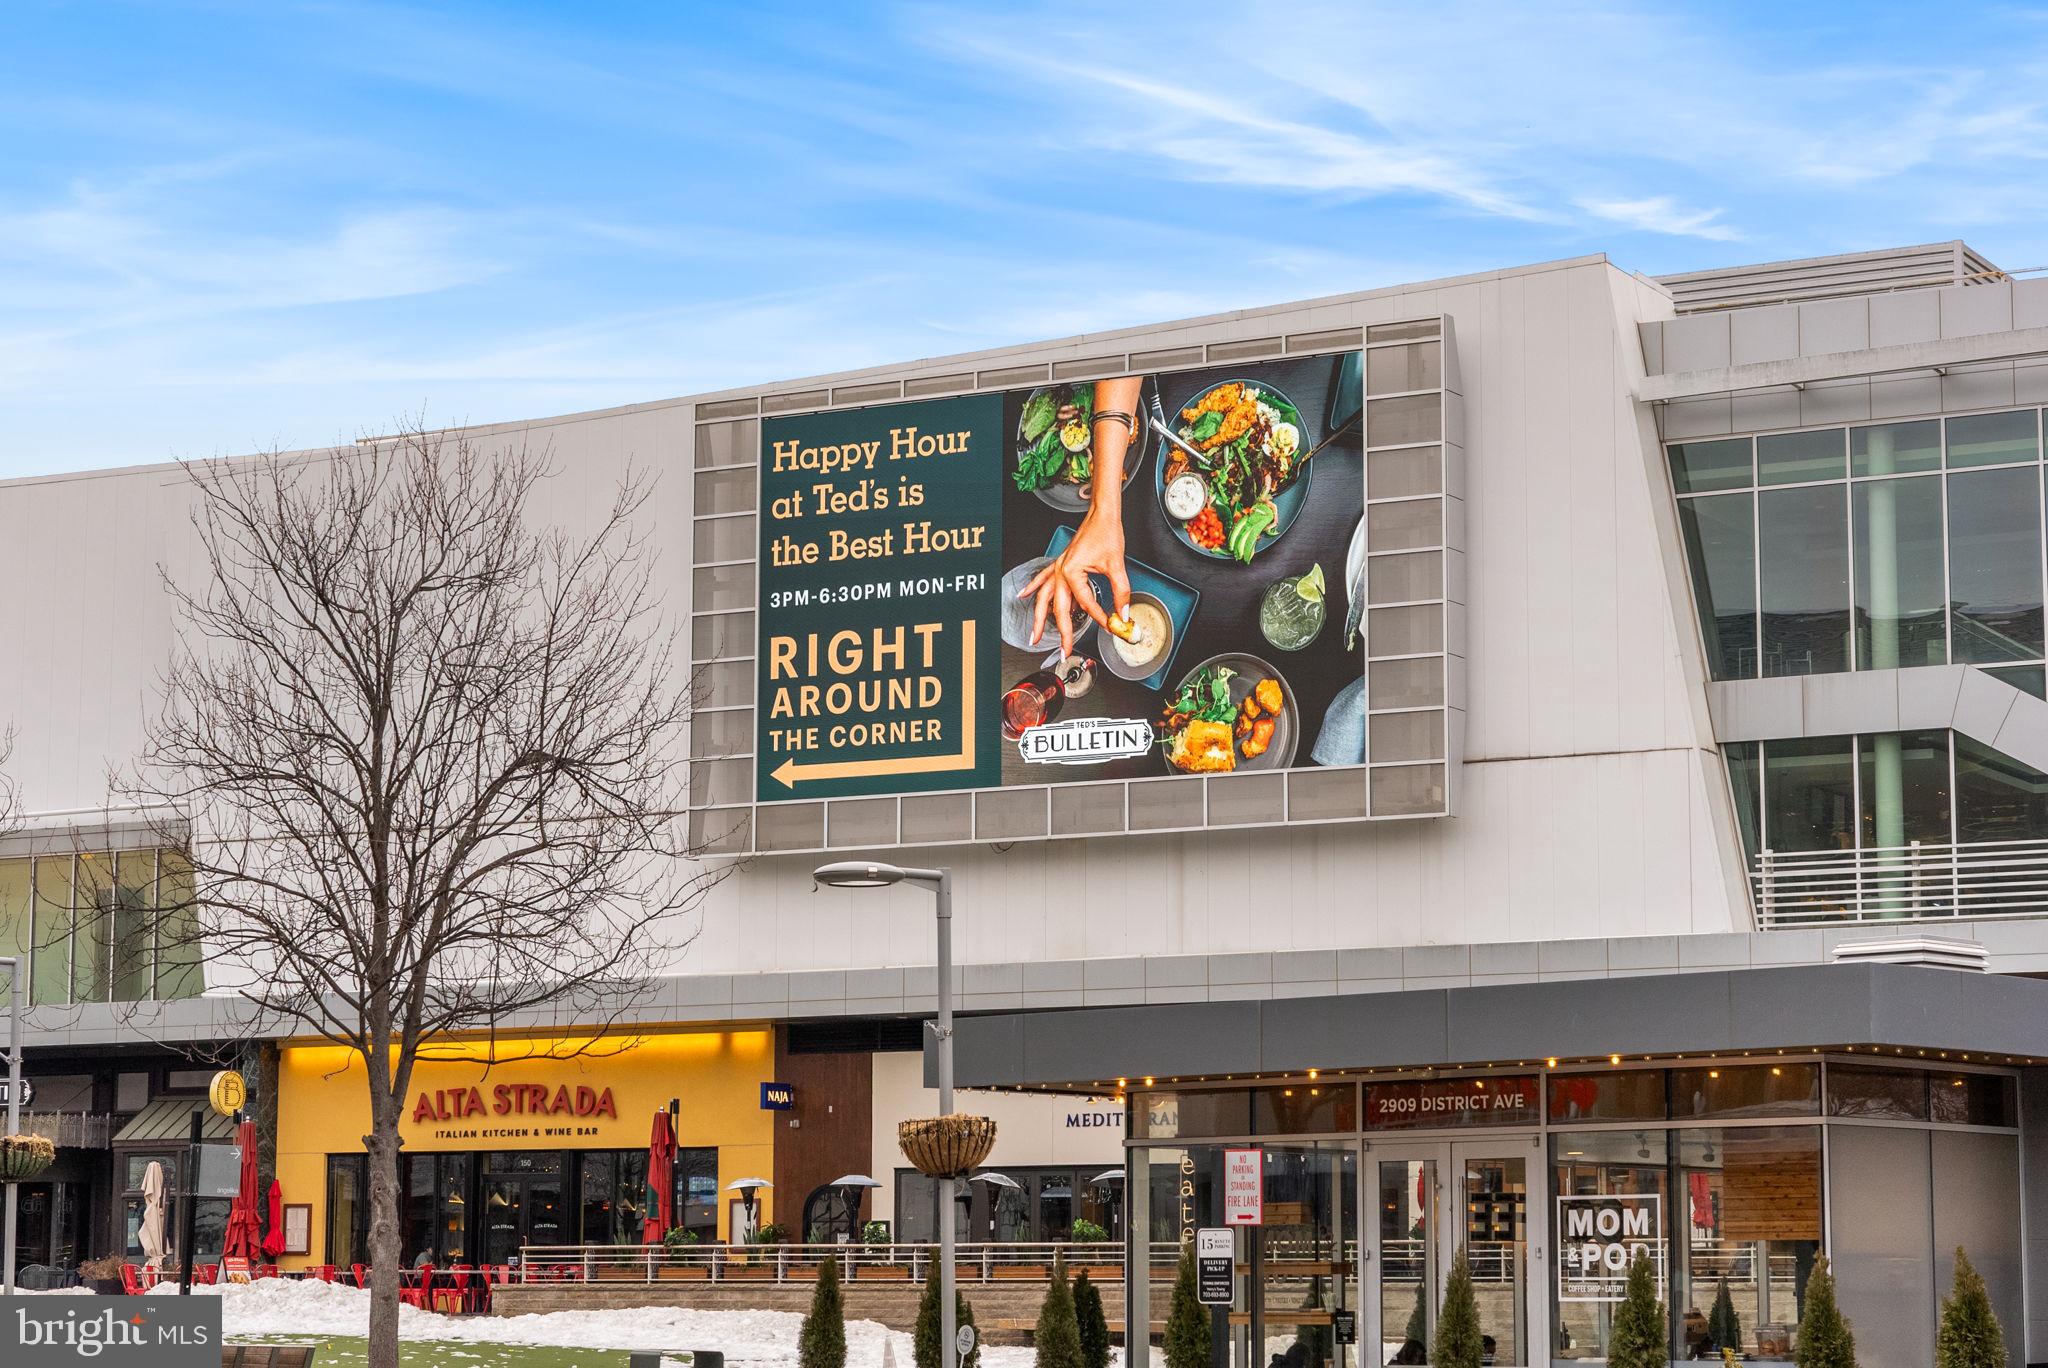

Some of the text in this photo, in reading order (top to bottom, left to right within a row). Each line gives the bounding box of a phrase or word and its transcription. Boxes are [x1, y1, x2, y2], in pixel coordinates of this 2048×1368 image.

[773, 427, 971, 474] Happy Hour
[772, 476, 924, 519] at Ted's is
[772, 522, 985, 566] the Best Hour
[770, 574, 985, 608] 3PM-6:30PM MON-FRI
[770, 623, 942, 680] RIGHT
[770, 676, 942, 719] AROUND
[770, 719, 942, 752] THE CORNER
[1034, 730, 1137, 753] BULLETIN
[413, 1084, 617, 1123] ALTA STRADA
[768, 1090, 789, 1104] NAJA
[1380, 1094, 1524, 1113] 2909 DISTRICT AVE
[435, 1127, 599, 1139] ITALIAN KITCHEN & WINE BAR
[1232, 1165, 1254, 1174] PARKING
[1239, 1155, 1247, 1164] NO
[1231, 1181, 1256, 1191] STANDING
[1227, 1196, 1259, 1208] FIRE LANE
[1568, 1208, 1649, 1236] MOM
[1202, 1239, 1213, 1249] 15
[1583, 1243, 1650, 1271] POP
[1568, 1285, 1624, 1293] COFFEE SHOP EATERY
